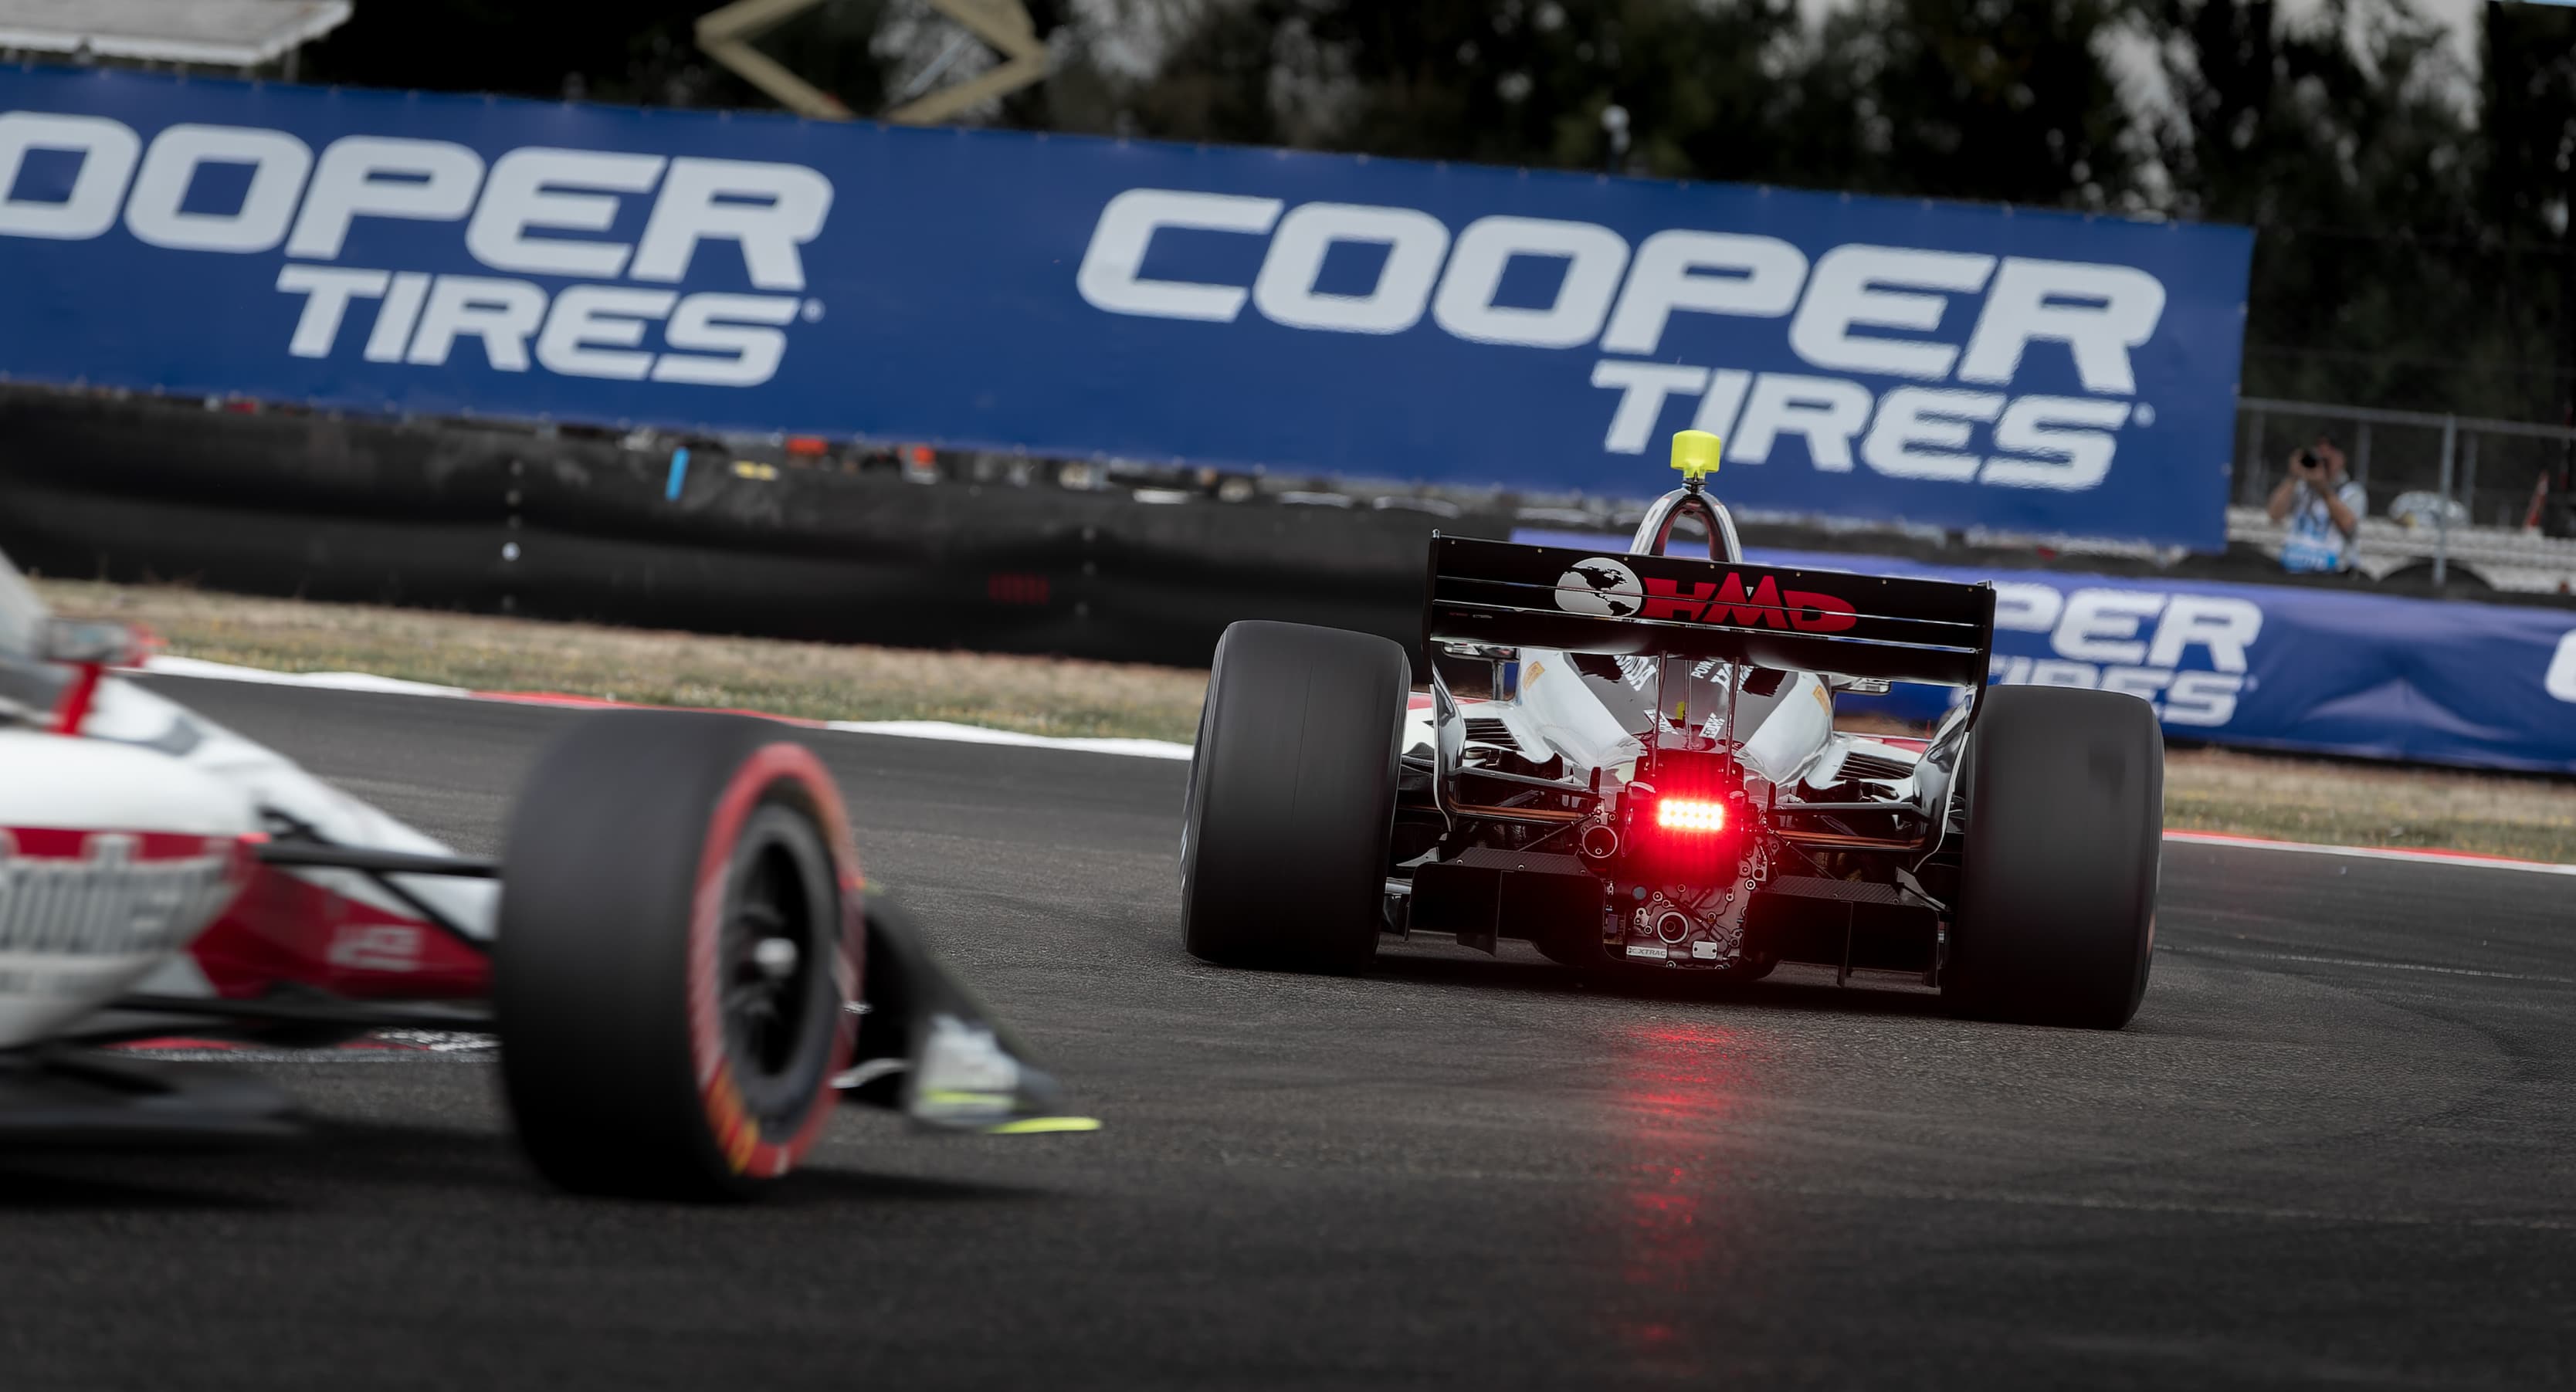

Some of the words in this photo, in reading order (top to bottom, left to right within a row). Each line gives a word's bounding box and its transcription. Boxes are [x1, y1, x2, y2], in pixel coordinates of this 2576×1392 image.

[276, 264, 801, 387] TIRES
[1077, 188, 2166, 395] COOPER
[1591, 360, 2132, 490] TIRES
[1642, 572, 1856, 631] HMD
